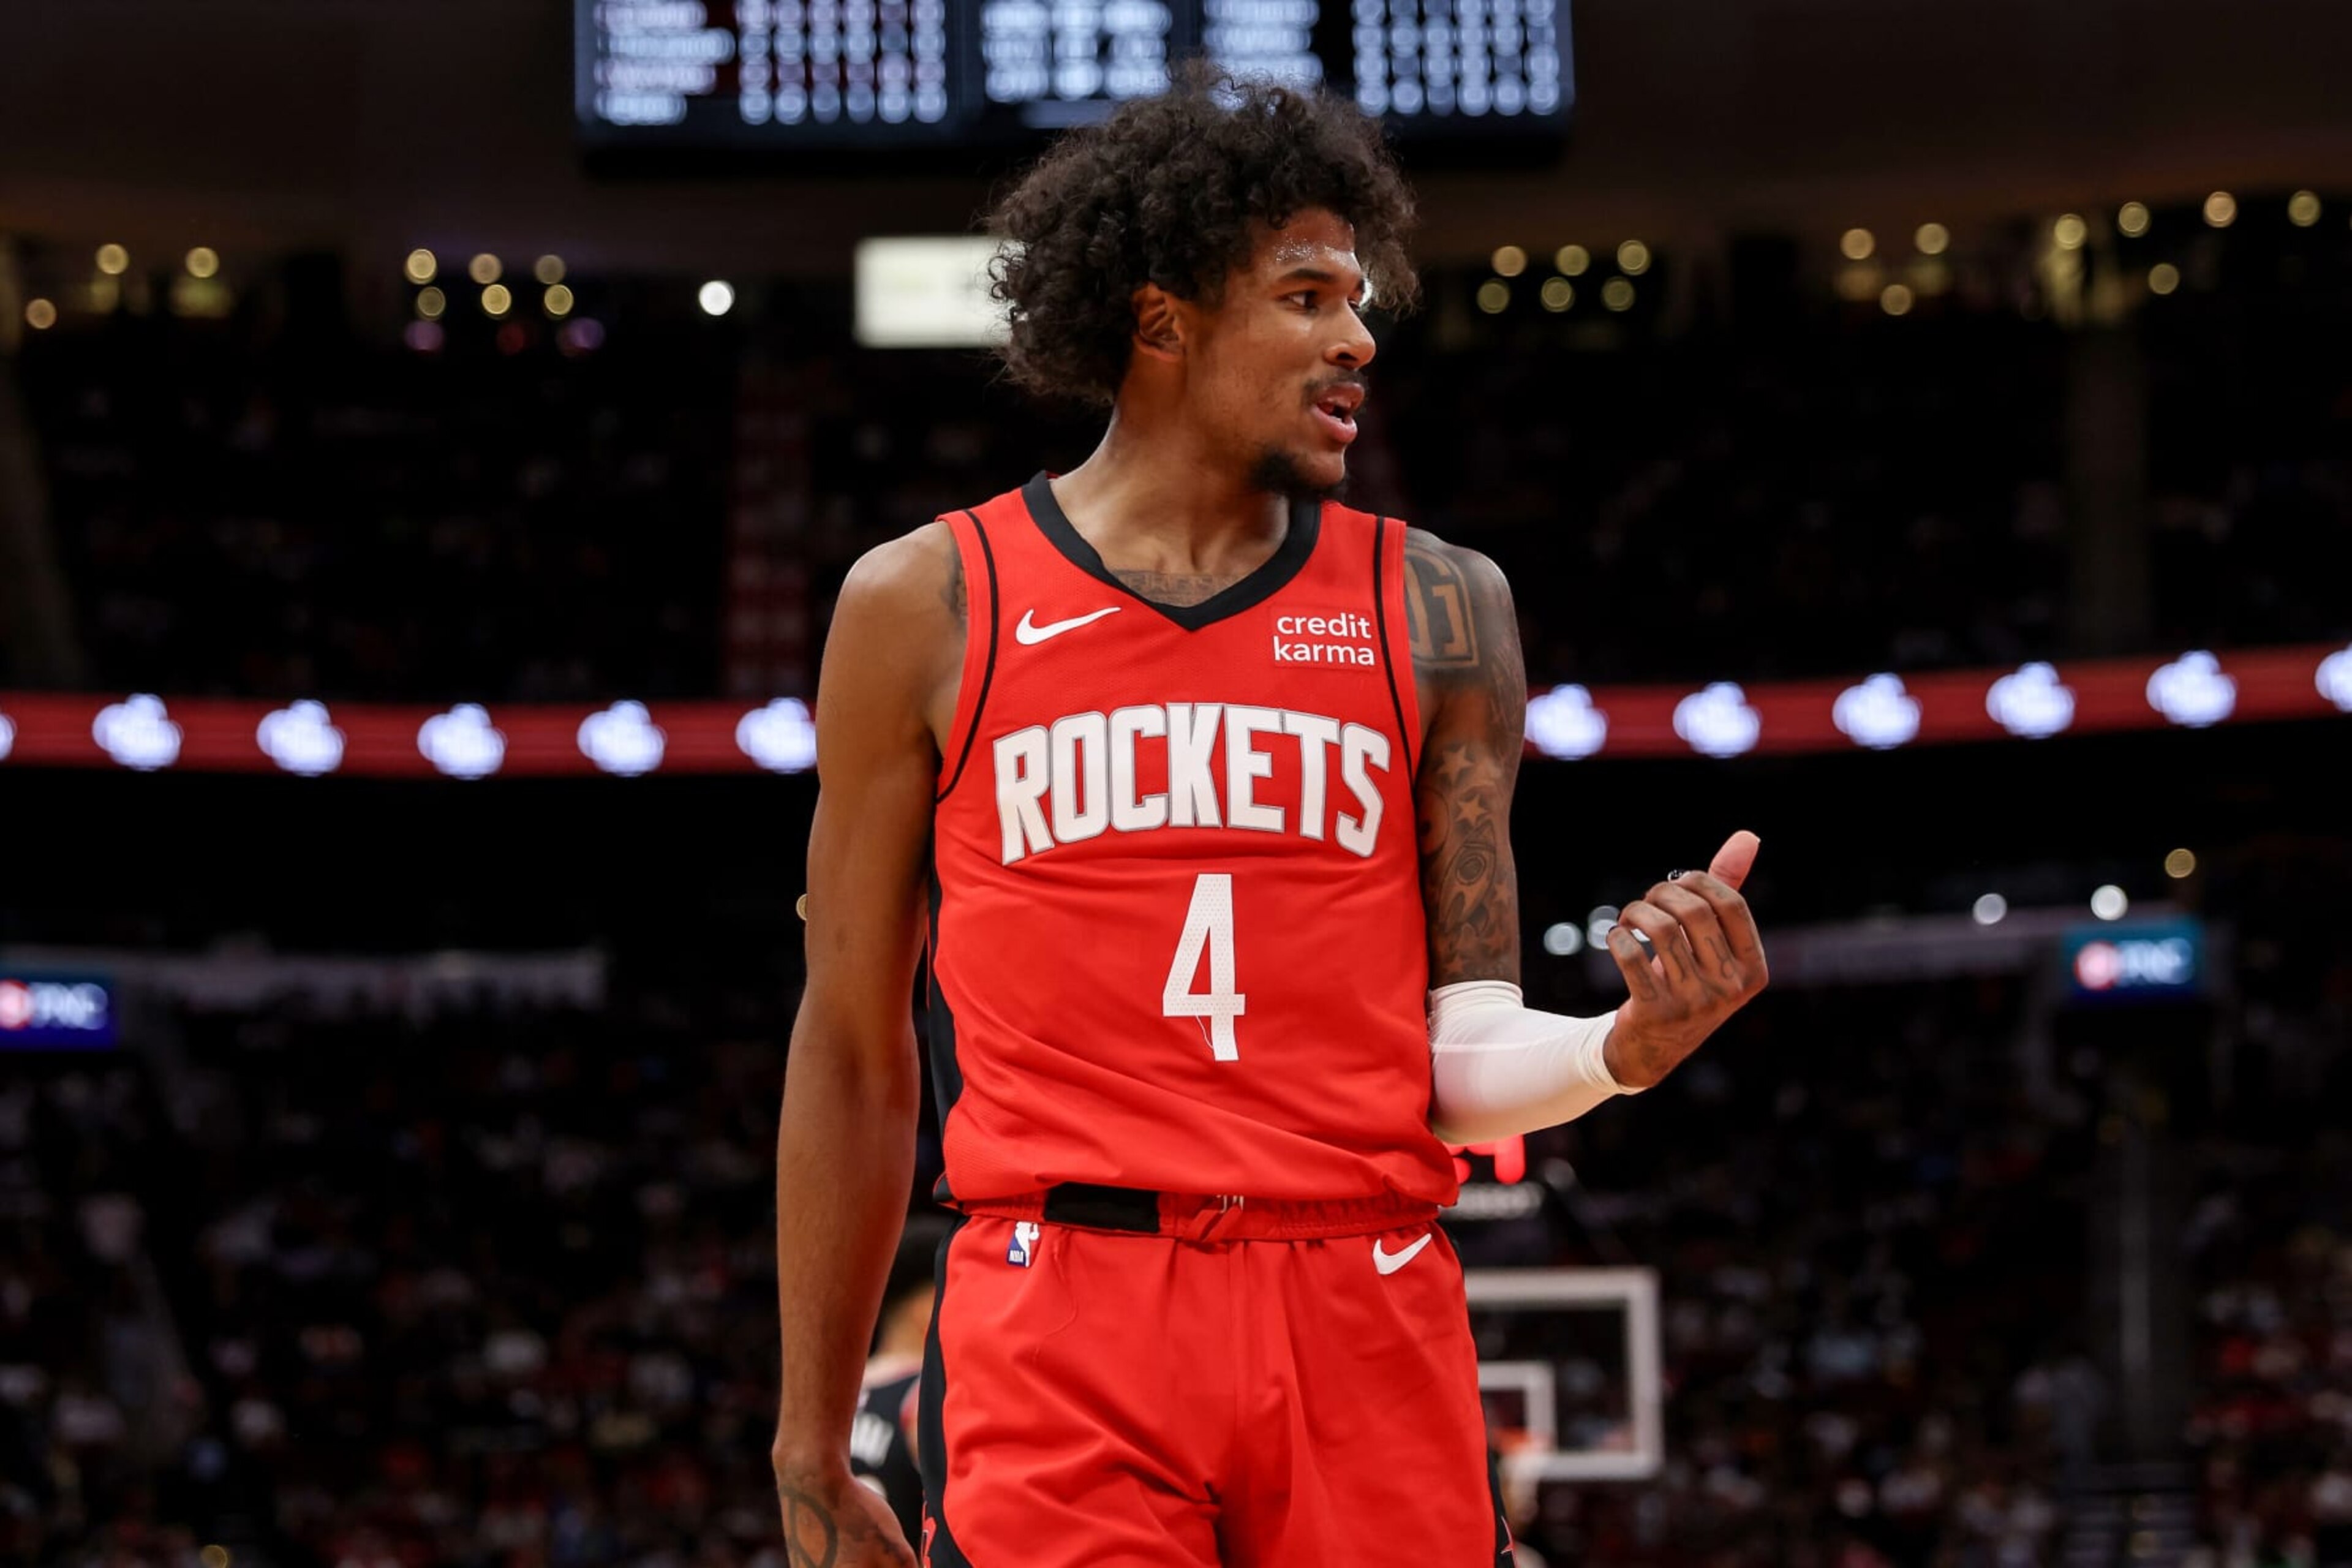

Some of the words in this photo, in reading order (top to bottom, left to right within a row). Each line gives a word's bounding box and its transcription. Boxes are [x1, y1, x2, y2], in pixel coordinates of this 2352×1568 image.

[1274, 636, 1375, 666] karma
[1277, 613, 1371, 638] credit
[993, 703, 1391, 865] ROCKETS
[1163, 873, 1246, 1062] 4
